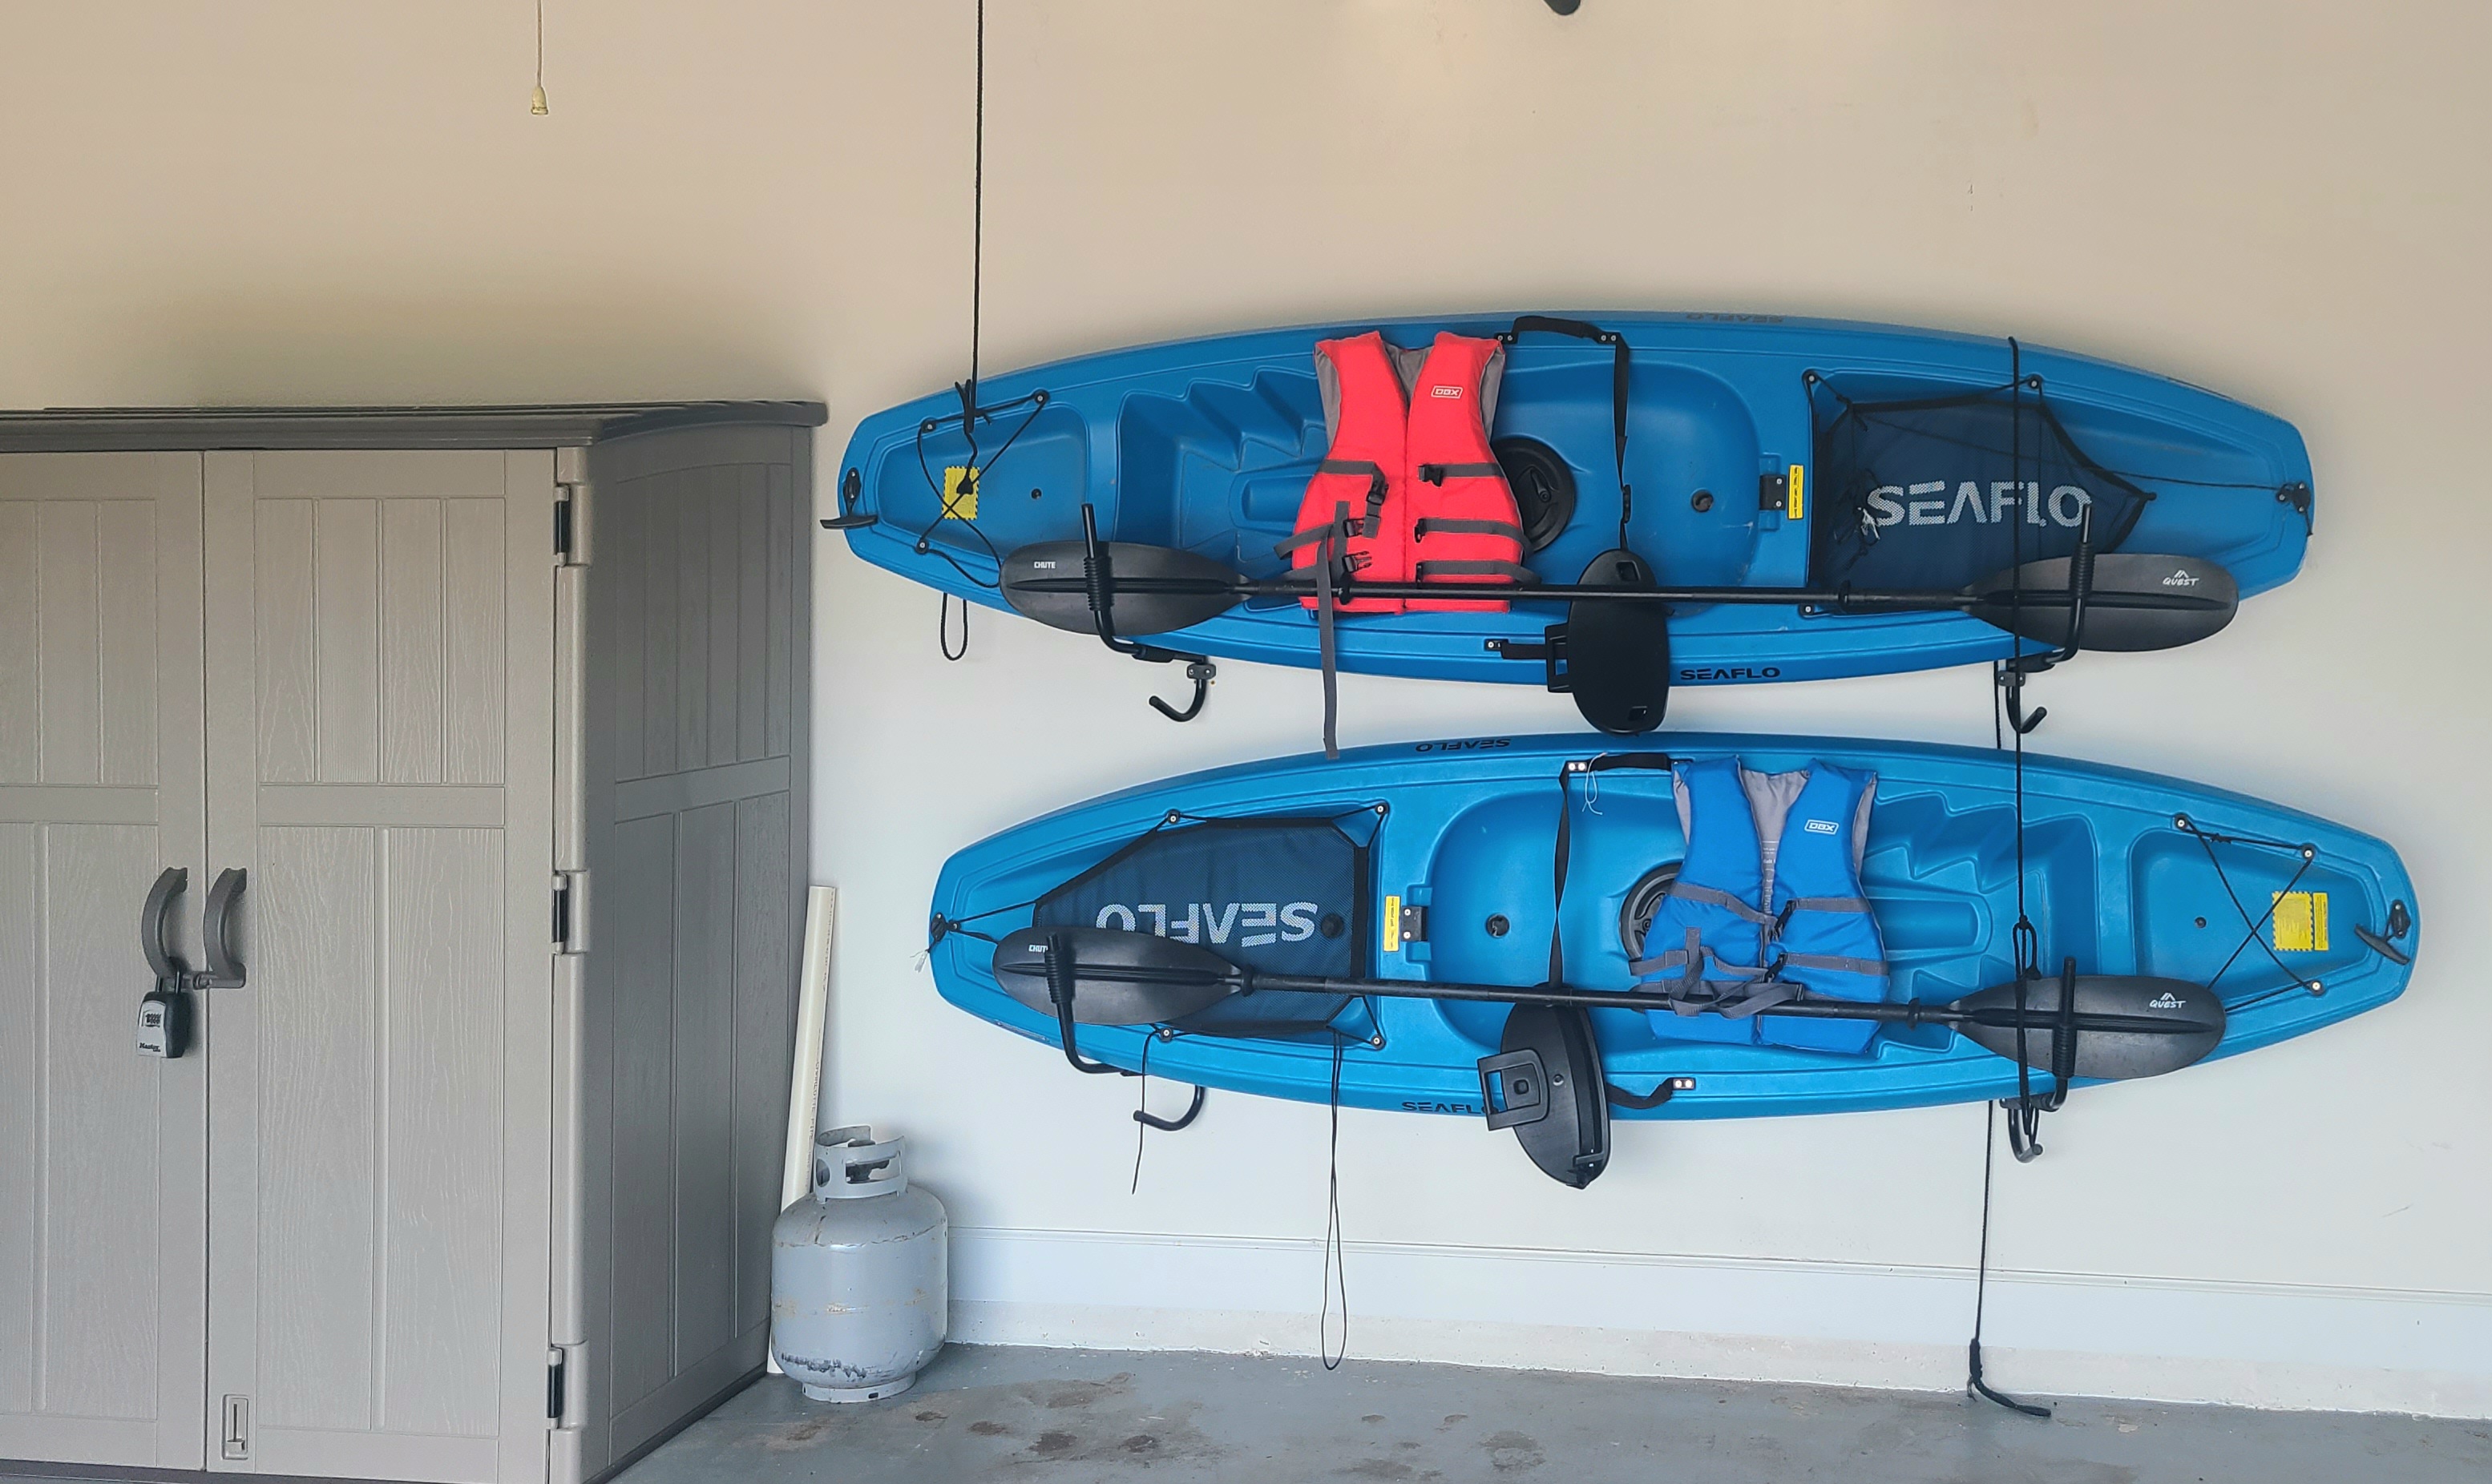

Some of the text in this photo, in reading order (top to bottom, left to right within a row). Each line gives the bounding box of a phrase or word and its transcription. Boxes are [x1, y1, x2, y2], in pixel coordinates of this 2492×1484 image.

[1435, 388, 1460, 396] DBX
[1867, 480, 2092, 527] SEAFLO
[1034, 561, 1056, 569] CHUTE
[2163, 577, 2199, 586] QUEST
[1680, 667, 1781, 680] SEAFLO
[1416, 738, 1512, 752] SEAFLO
[1808, 822, 1836, 832] DBX
[1096, 901, 1319, 947] SEAFLO
[2149, 999, 2187, 1009] QUEST
